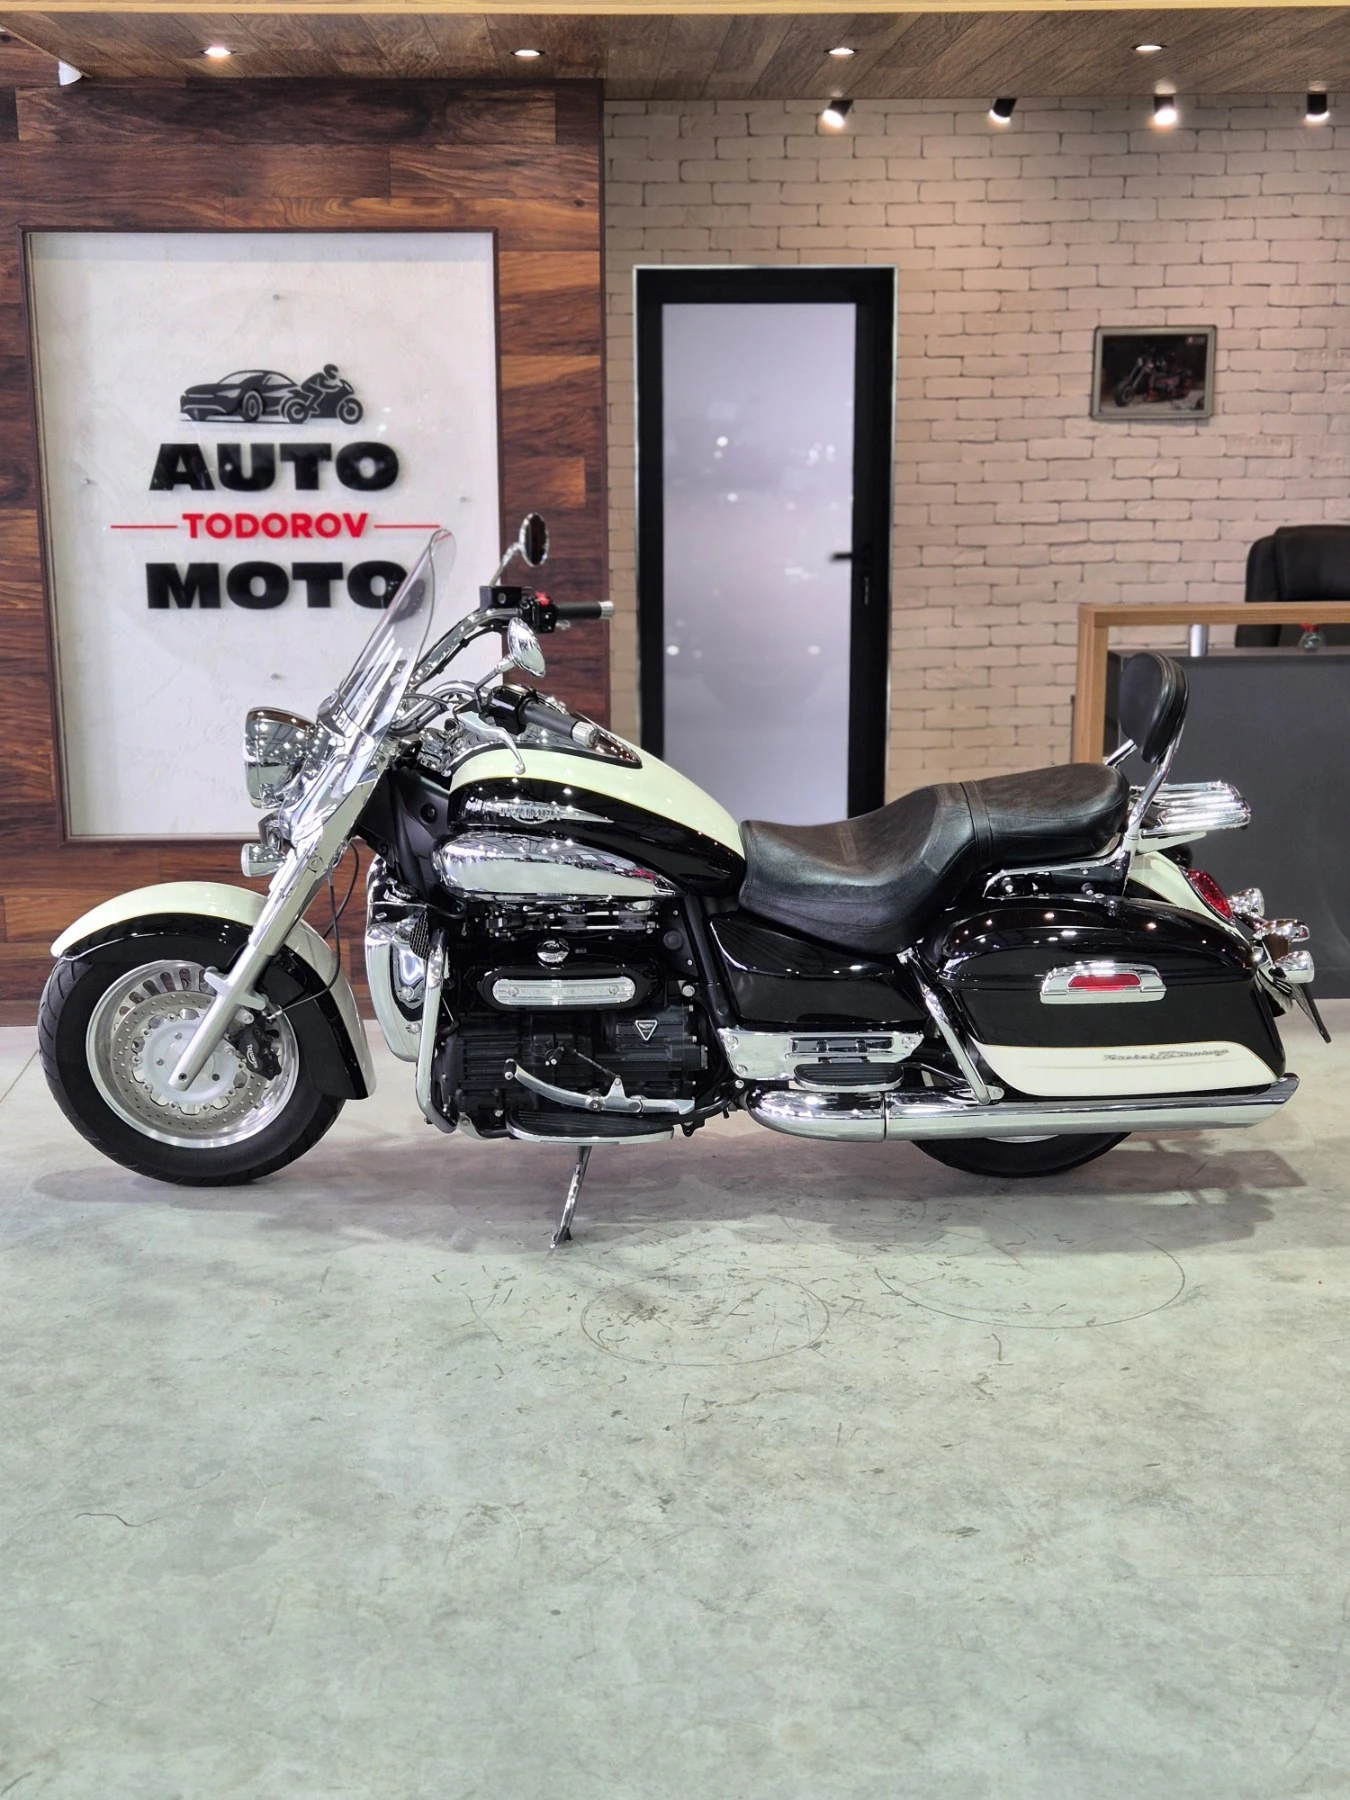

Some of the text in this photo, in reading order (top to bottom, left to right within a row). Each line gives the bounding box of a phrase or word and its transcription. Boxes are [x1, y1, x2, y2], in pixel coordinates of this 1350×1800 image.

[149, 441, 400, 492] AUTO
[182, 512, 369, 539] TODOROV
[146, 560, 407, 610] MOTO
